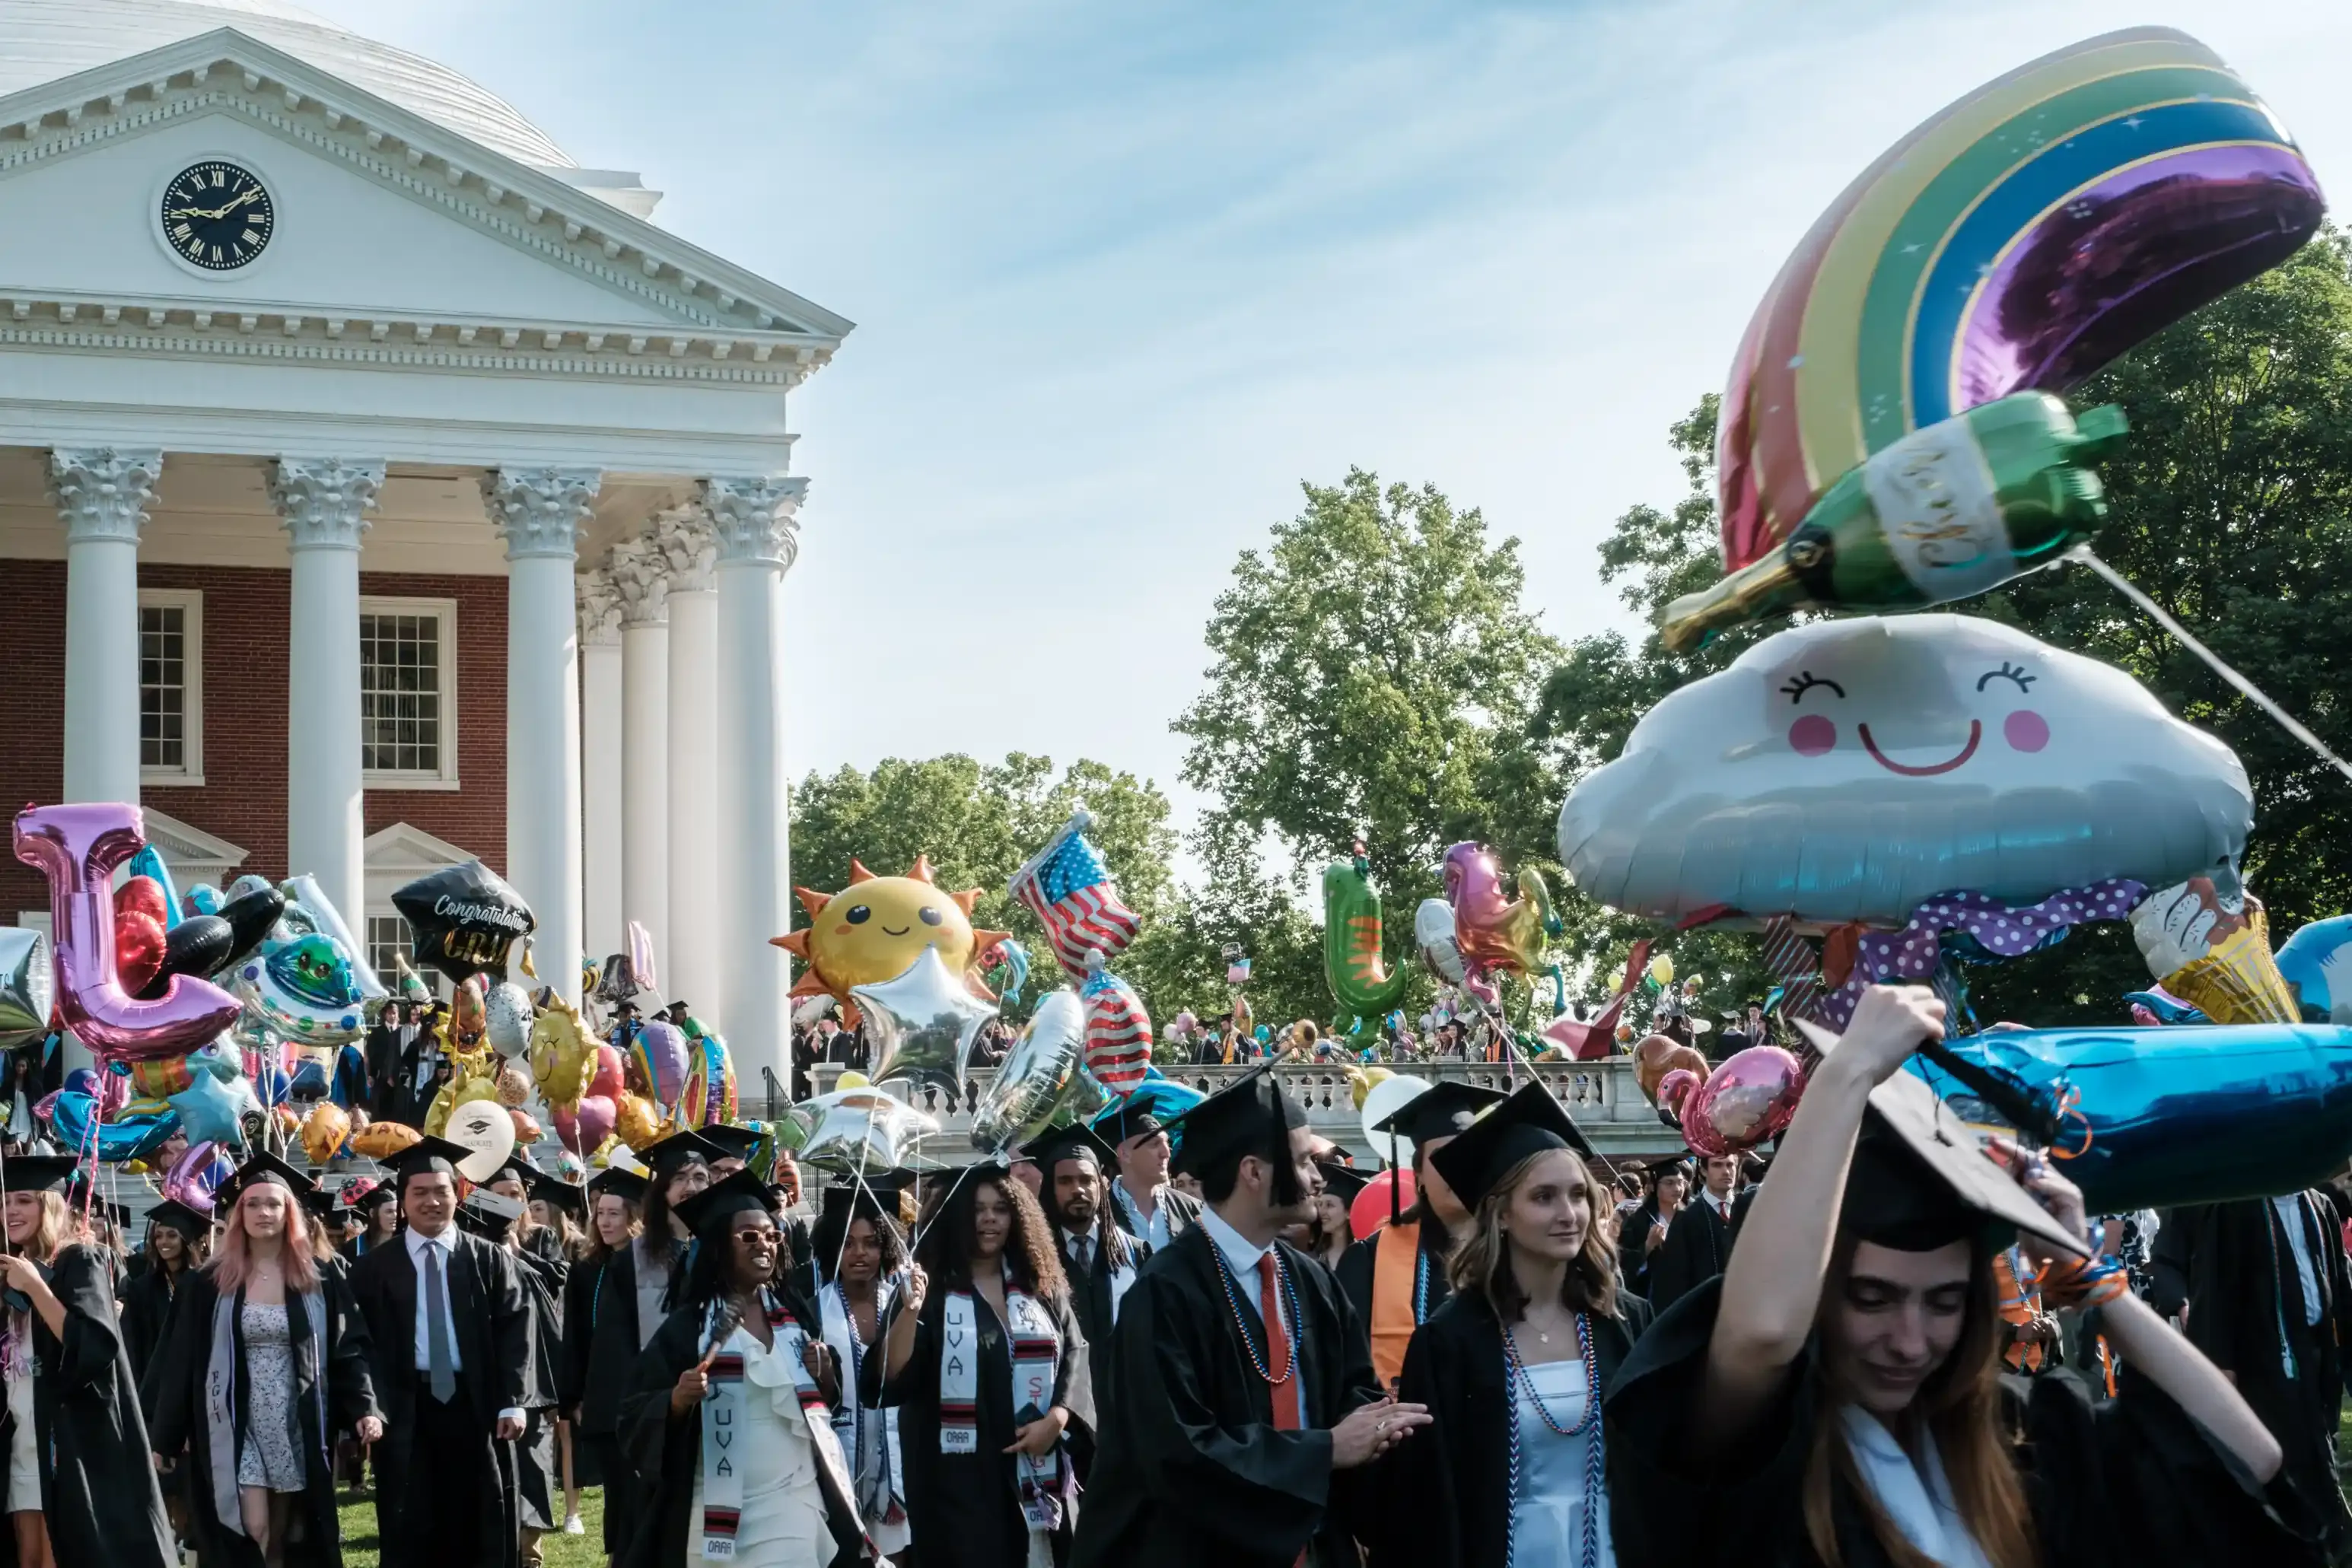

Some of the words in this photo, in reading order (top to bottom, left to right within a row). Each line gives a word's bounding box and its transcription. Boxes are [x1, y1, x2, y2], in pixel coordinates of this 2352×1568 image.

[190, 173, 207, 192] XI
[212, 170, 224, 187] XII
[176, 189, 193, 202] X
[212, 246, 223, 262] VI
[947, 1312, 963, 1376] UVA
[715, 1409, 733, 1477] UVA
